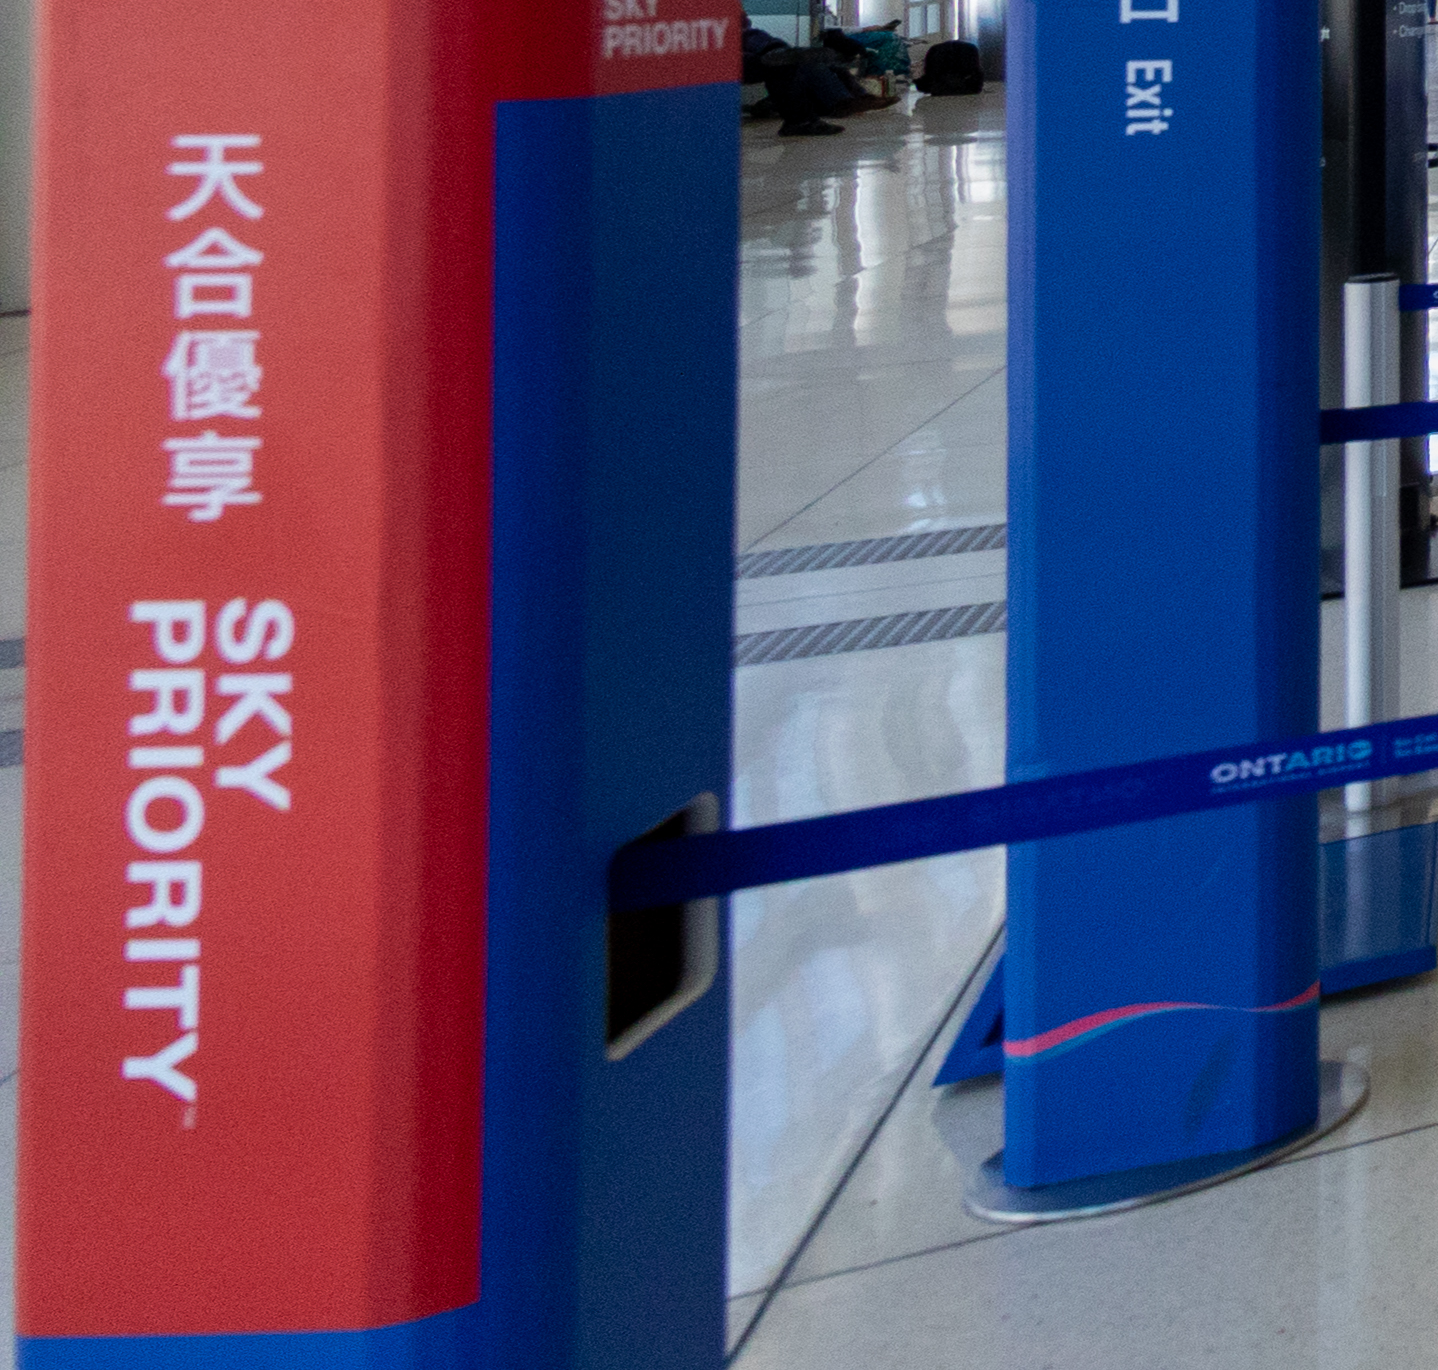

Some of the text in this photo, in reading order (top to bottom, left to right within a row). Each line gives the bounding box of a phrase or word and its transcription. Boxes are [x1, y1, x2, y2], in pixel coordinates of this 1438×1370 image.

[604, 17, 730, 59] PRIORITY
[1125, 59, 1174, 137] Exit
[163, 132, 264, 525] 天合優享
[1210, 738, 1373, 785] ONTARIO
[121, 594, 295, 1106] SKY PRIORITY
